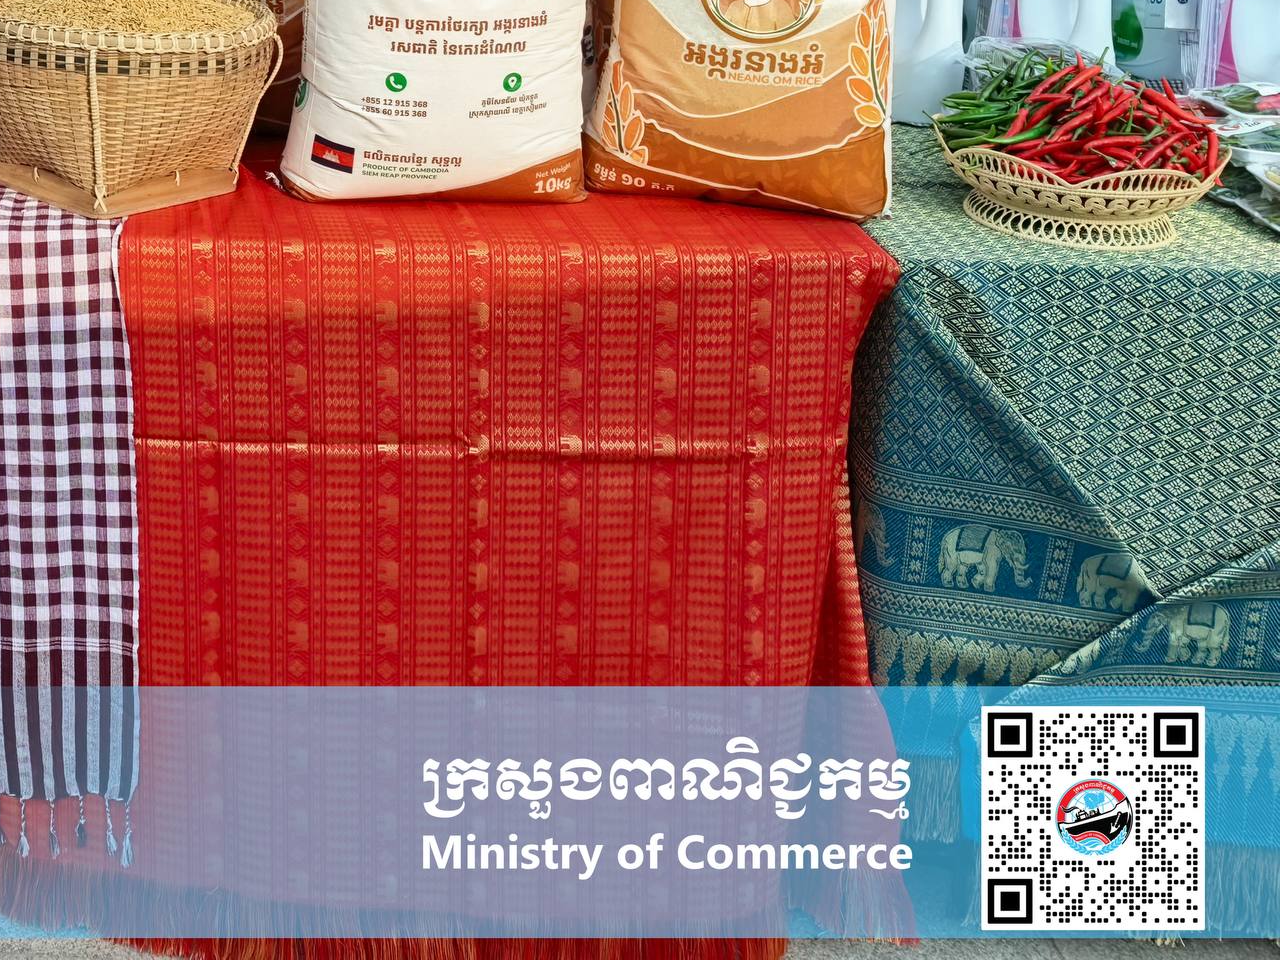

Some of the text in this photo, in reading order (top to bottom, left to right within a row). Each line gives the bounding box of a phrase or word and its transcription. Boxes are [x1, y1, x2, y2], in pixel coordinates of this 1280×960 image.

[728, 71, 822, 85] NEANG OM RICE
[361, 96, 380, 105] +855
[382, 108, 392, 116] 60
[362, 163, 397, 172] PRODUCT
[380, 171, 399, 179] REAP
[535, 170, 549, 179] Net
[534, 176, 571, 194] 10kg
[622, 173, 645, 188] ១០
